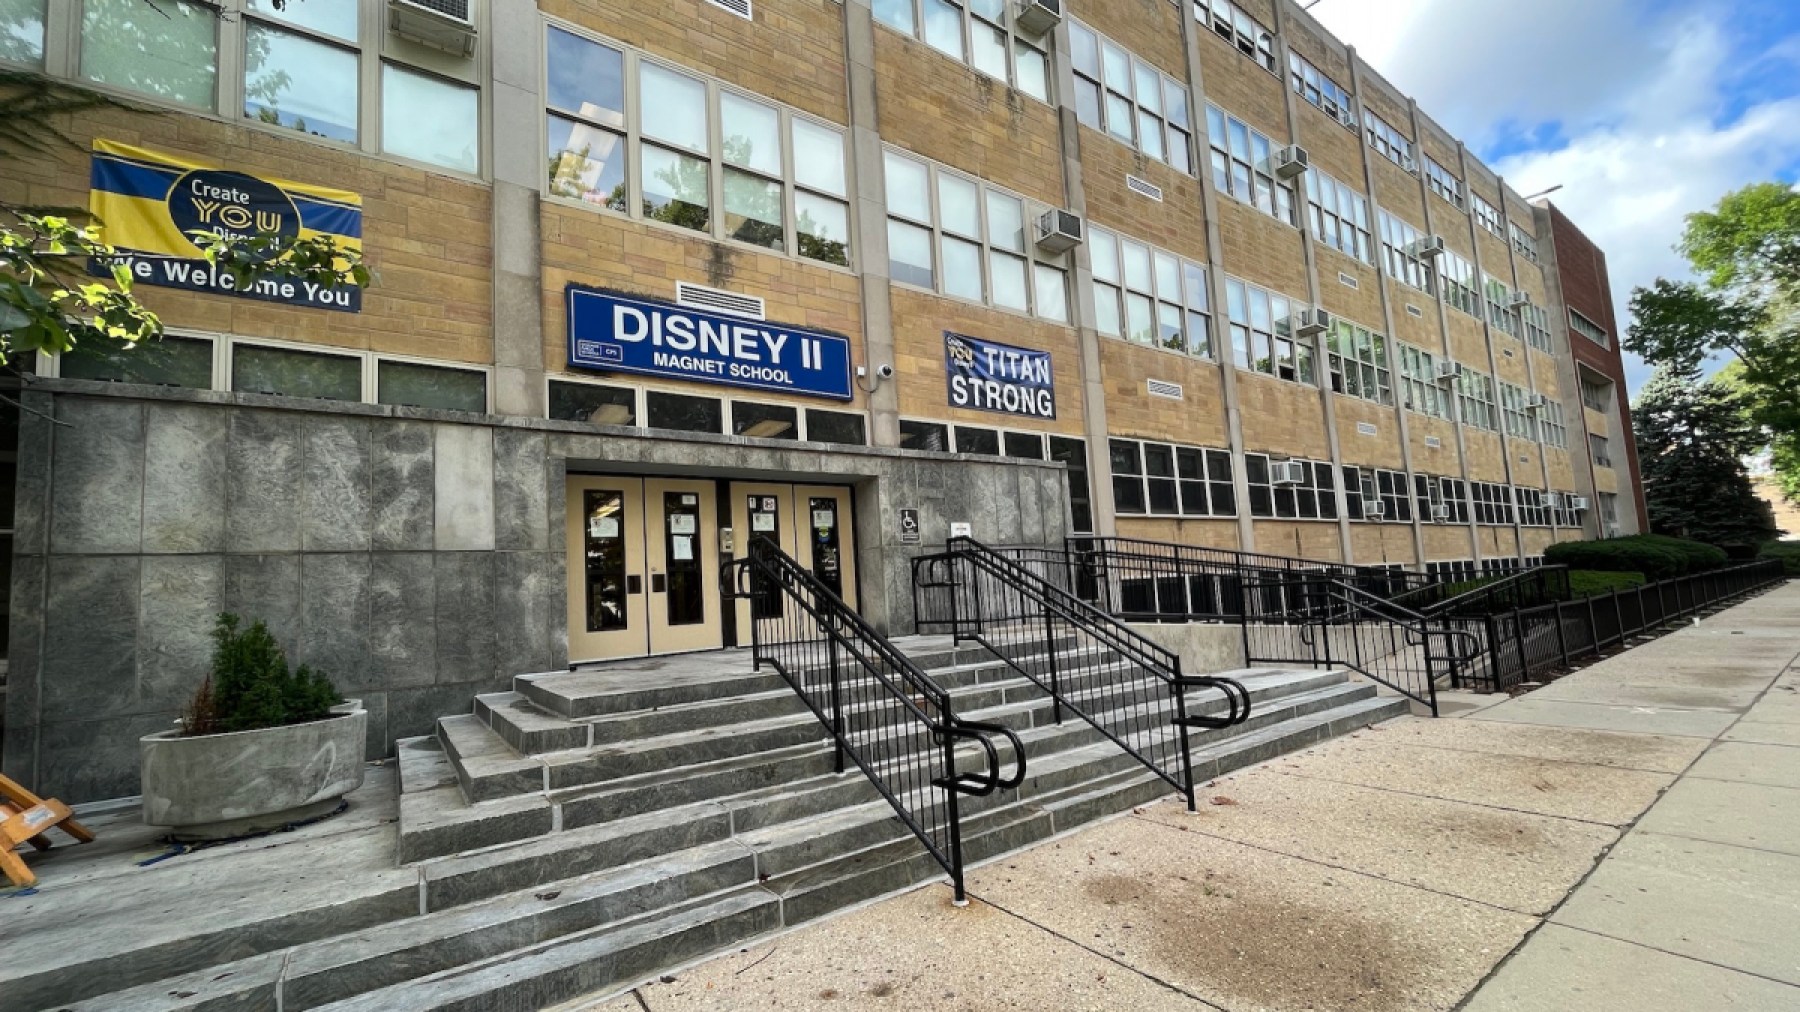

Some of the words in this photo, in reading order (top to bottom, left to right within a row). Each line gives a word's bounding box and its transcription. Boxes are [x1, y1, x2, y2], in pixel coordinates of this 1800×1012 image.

[191, 179, 250, 205] Create
[191, 197, 281, 233] YOU
[162, 259, 295, 298] Welcme
[303, 281, 350, 307] You
[613, 304, 789, 364] DISNEY
[801, 337, 823, 371] II
[653, 351, 725, 375] MAGNET
[729, 362, 793, 384] SCHOOL
[983, 346, 1051, 385] TITAN
[951, 374, 1053, 417] STRONG
